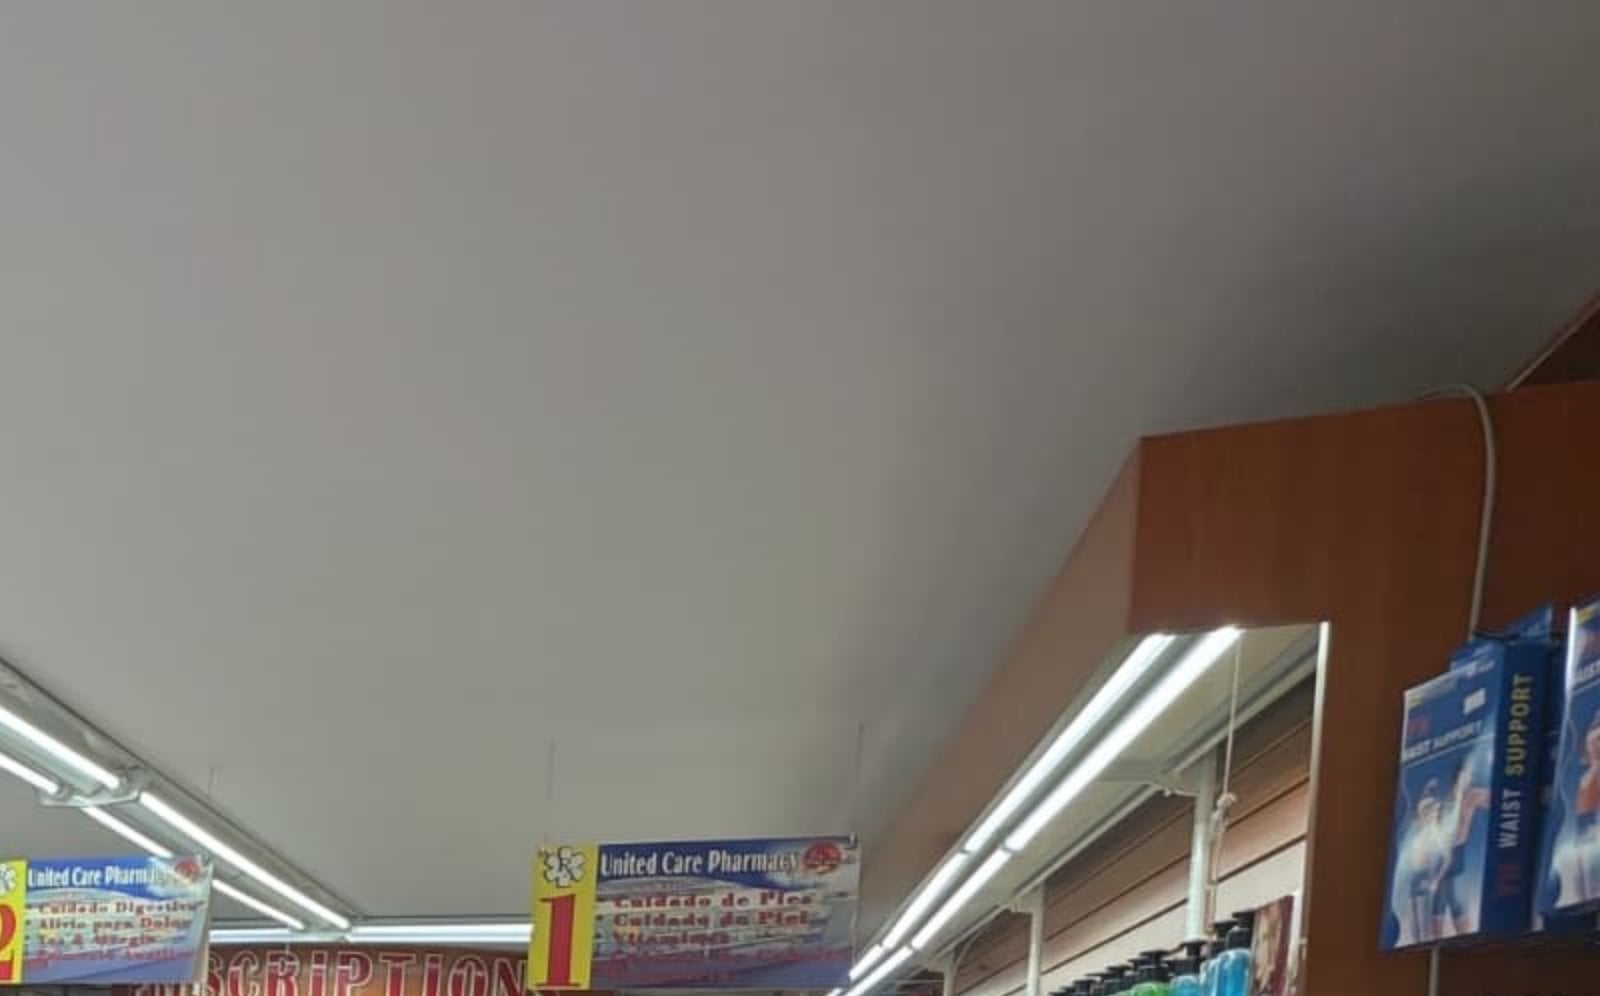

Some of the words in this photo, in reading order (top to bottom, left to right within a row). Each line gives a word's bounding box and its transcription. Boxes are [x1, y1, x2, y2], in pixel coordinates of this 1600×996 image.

[1504, 672, 1534, 776] SUPPORT
[1499, 788, 1521, 849] WAIST
[601, 852, 656, 876] United
[662, 851, 703, 874] Care
[708, 849, 798, 874] Pharmacy
[28, 866, 69, 887] United
[72, 867, 101, 886] Care
[39, 901, 108, 914] Cuidado
[613, 893, 711, 908] Cuidado
[721, 892, 750, 907] de
[613, 912, 711, 927] Cuidado
[719, 911, 750, 926] de
[535, 894, 582, 987] 1
